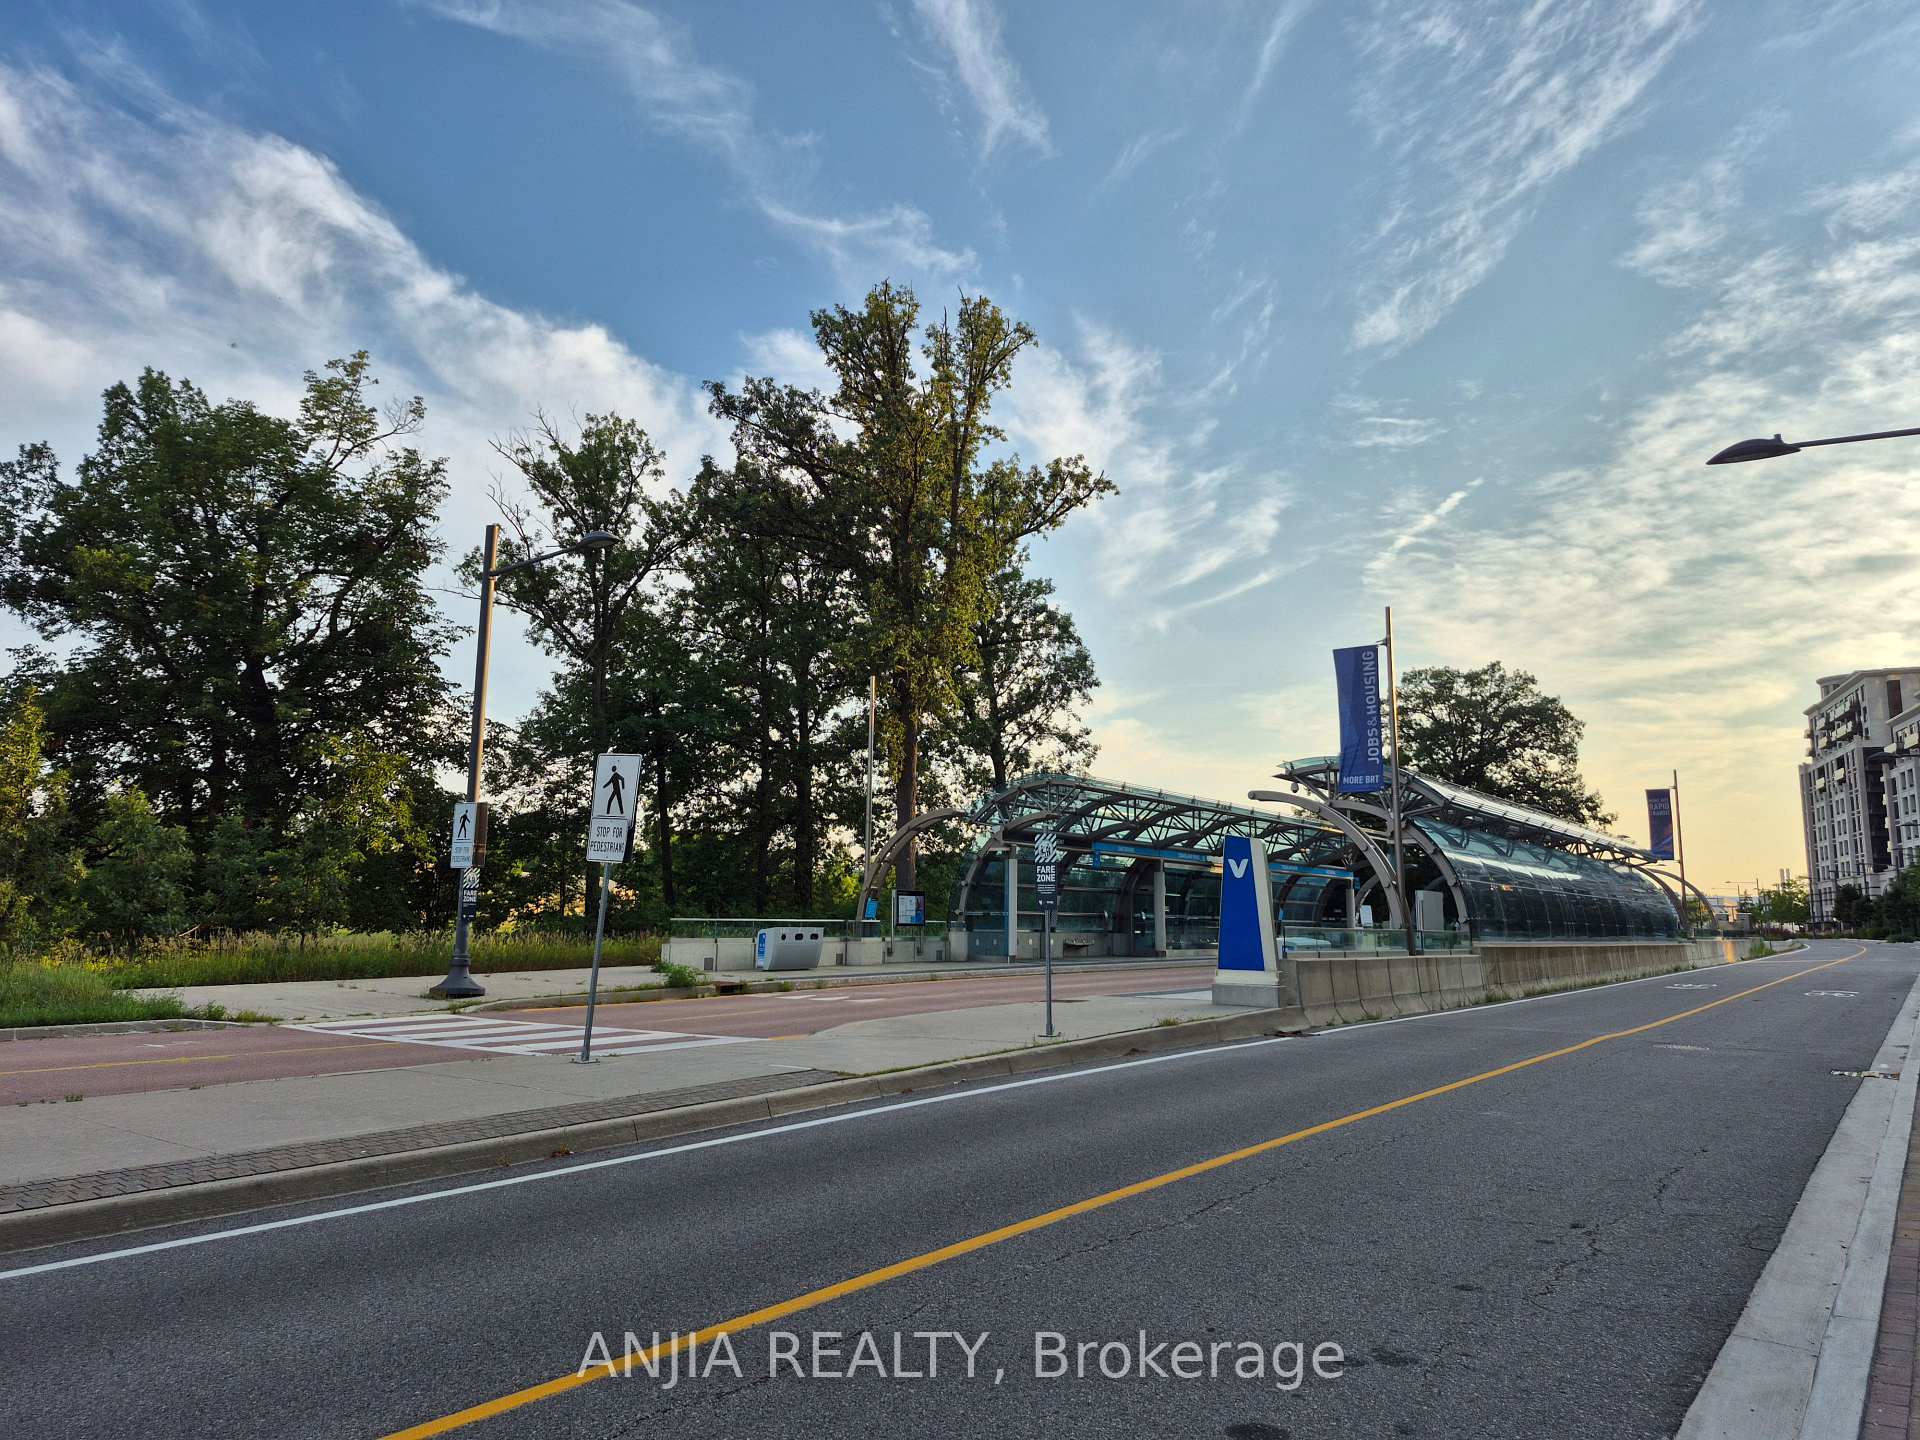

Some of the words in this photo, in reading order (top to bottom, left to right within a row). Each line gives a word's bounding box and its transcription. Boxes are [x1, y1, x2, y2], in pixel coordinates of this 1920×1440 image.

[1362, 650, 1376, 714] HOUSING
[1367, 717, 1377, 726] &
[1367, 728, 1379, 764] JOBS
[1343, 776, 1363, 785] MORE
[1365, 775, 1379, 784] BRT
[597, 826, 610, 838] STOP
[613, 827, 623, 838] FOR
[590, 840, 624, 853] PEDESTRIANS
[1036, 865, 1056, 874] FARE
[1036, 874, 1056, 882] ZONE
